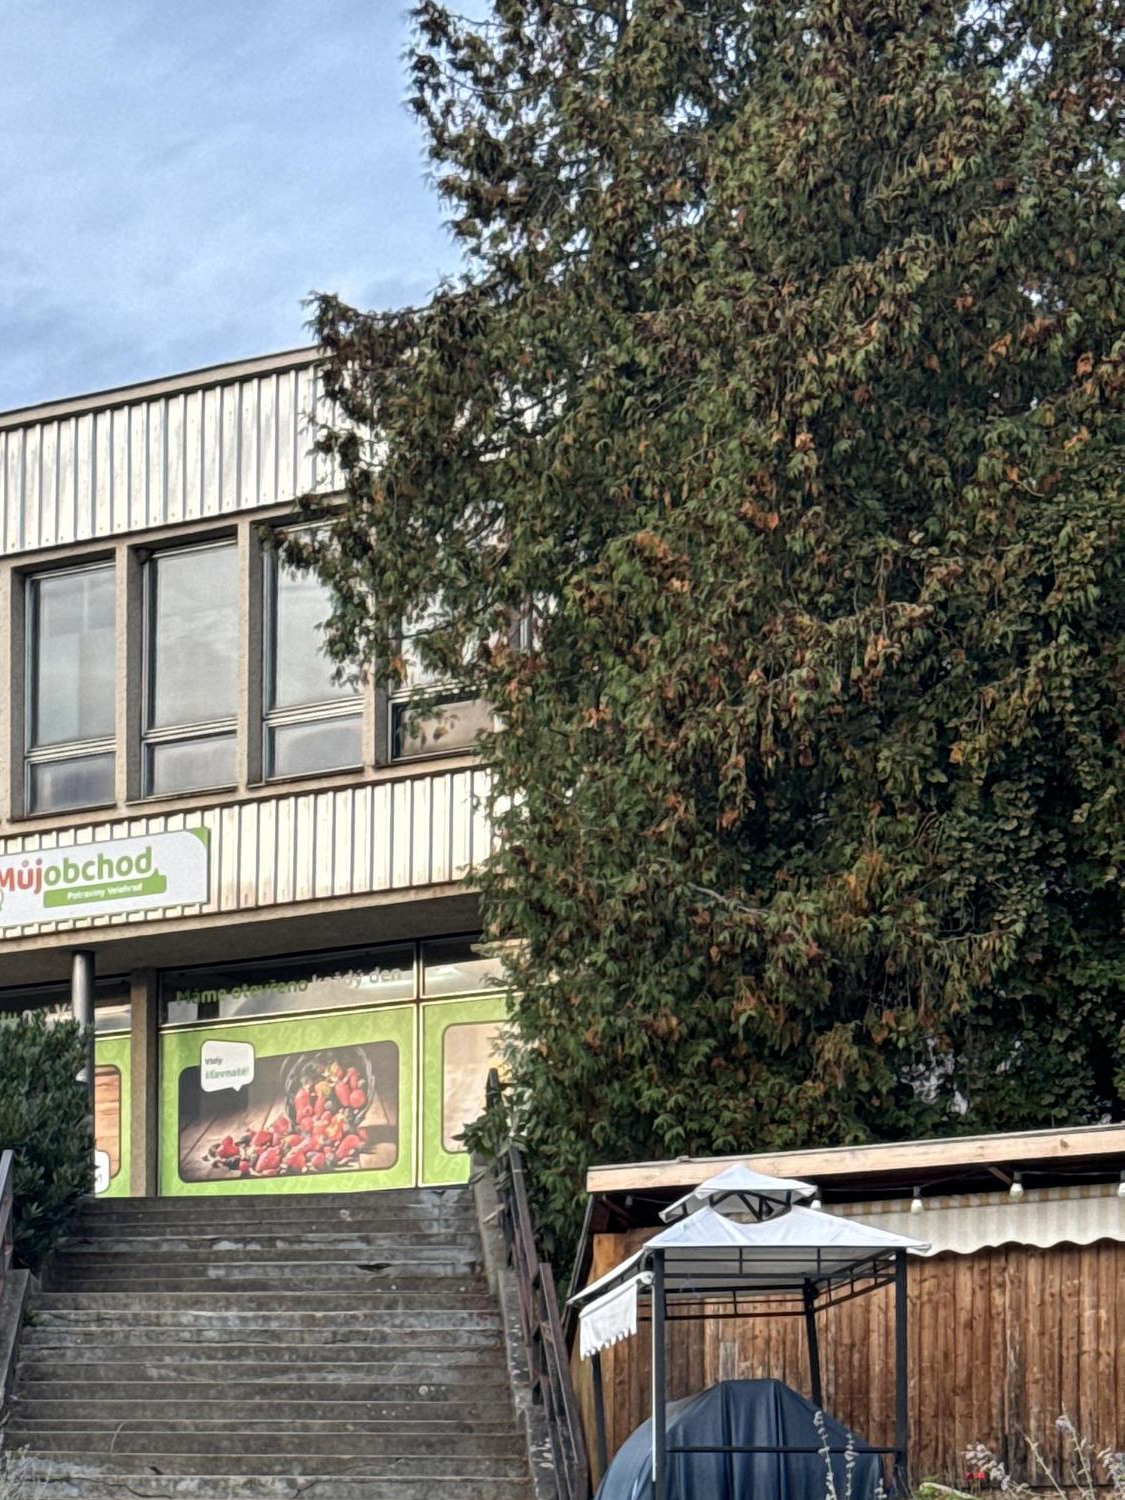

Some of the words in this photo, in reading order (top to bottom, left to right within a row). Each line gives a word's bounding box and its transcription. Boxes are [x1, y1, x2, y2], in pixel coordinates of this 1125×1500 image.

[176, 988, 225, 1004] Máme
[231, 979, 309, 999] otevřeno
[369, 967, 402, 982] den
